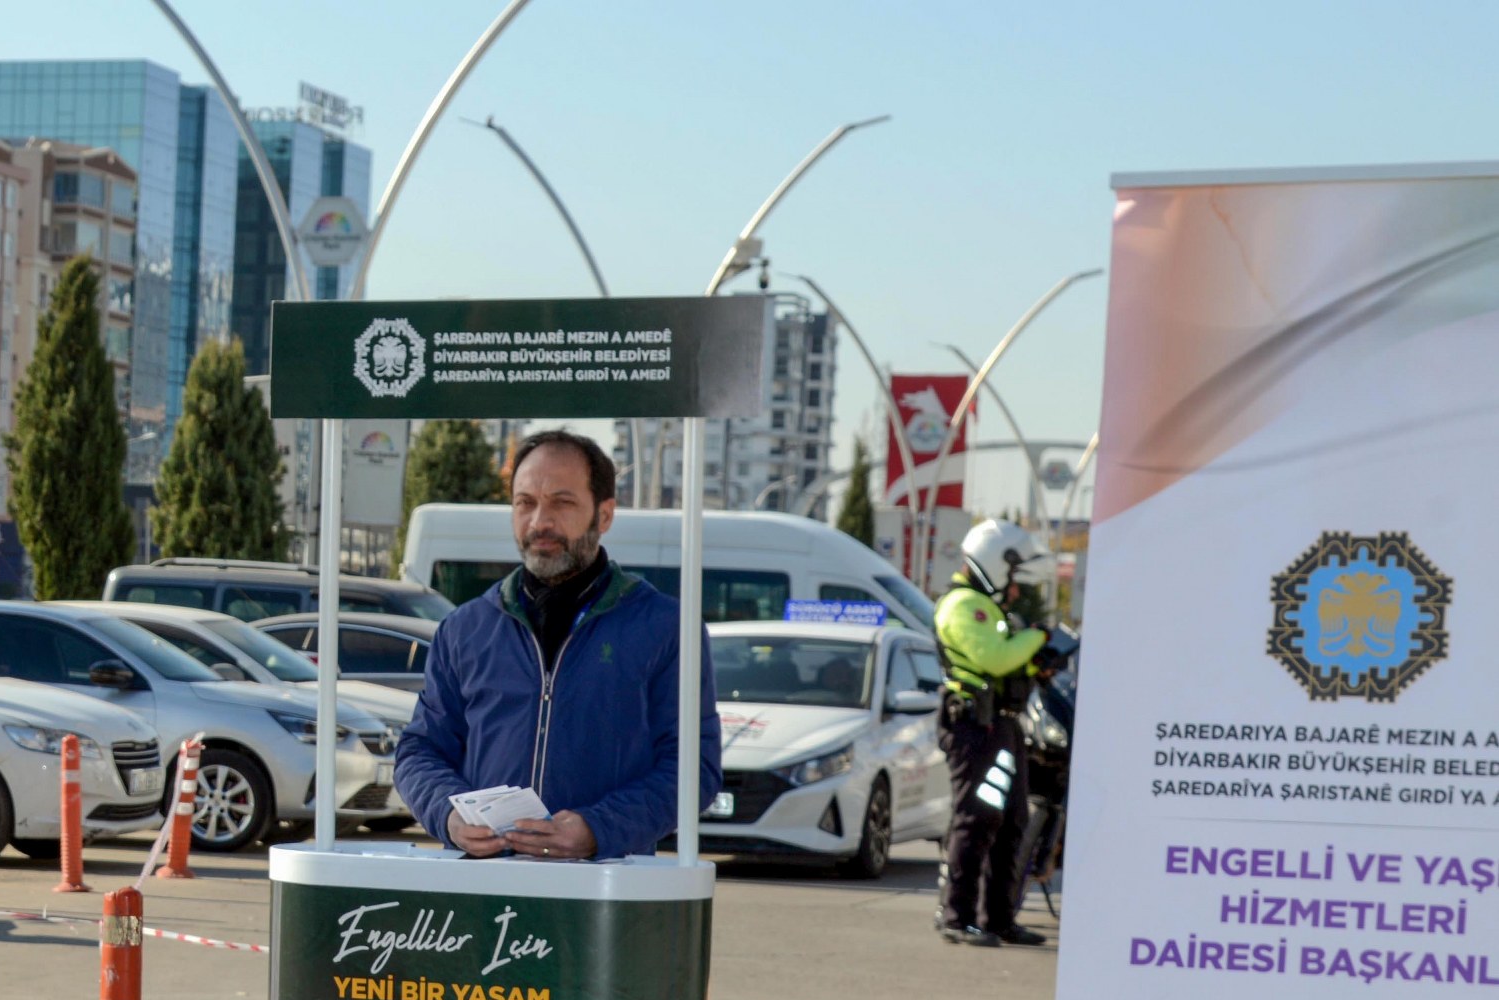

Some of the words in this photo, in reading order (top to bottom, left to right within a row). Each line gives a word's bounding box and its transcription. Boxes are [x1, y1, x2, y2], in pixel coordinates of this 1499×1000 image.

[433, 332, 511, 346] ŞAREDARIYA
[513, 329, 564, 345] BAJARÊ
[567, 331, 609, 344] MEZIN
[611, 331, 622, 343] A
[624, 328, 672, 343] AMEDÊ
[433, 348, 508, 364] DİYARBAKIR
[510, 348, 592, 366] BÜYÜKŞEHİR
[594, 346, 671, 363] BELEDİYESİ
[507, 366, 574, 383] ŞARISTANÊ
[611, 370, 628, 381] YA
[1155, 722, 1288, 742] ŞAREDARIYA
[1295, 724, 1380, 744] BAJARÊ
[1387, 728, 1455, 746] MEZIN
[1462, 731, 1477, 747] A
[1154, 748, 1281, 770] DİYARBAKIR
[1287, 750, 1426, 775] BÜYÜKŞEHİR
[1280, 782, 1392, 802] ŞARISTANÊ
[1460, 789, 1486, 806] YA
[1165, 844, 1334, 881] ENGELLİ
[1347, 852, 1402, 884] VE
[1414, 855, 1499, 893] YAŞ
[1220, 889, 1467, 935] HİZMETLERİ
[333, 901, 473, 974] Engelliler
[481, 905, 553, 975] İçin
[1129, 933, 1287, 974] DAİRESİ
[1299, 946, 1499, 986] BAŞKANL
[333, 974, 394, 1000] YENİ
